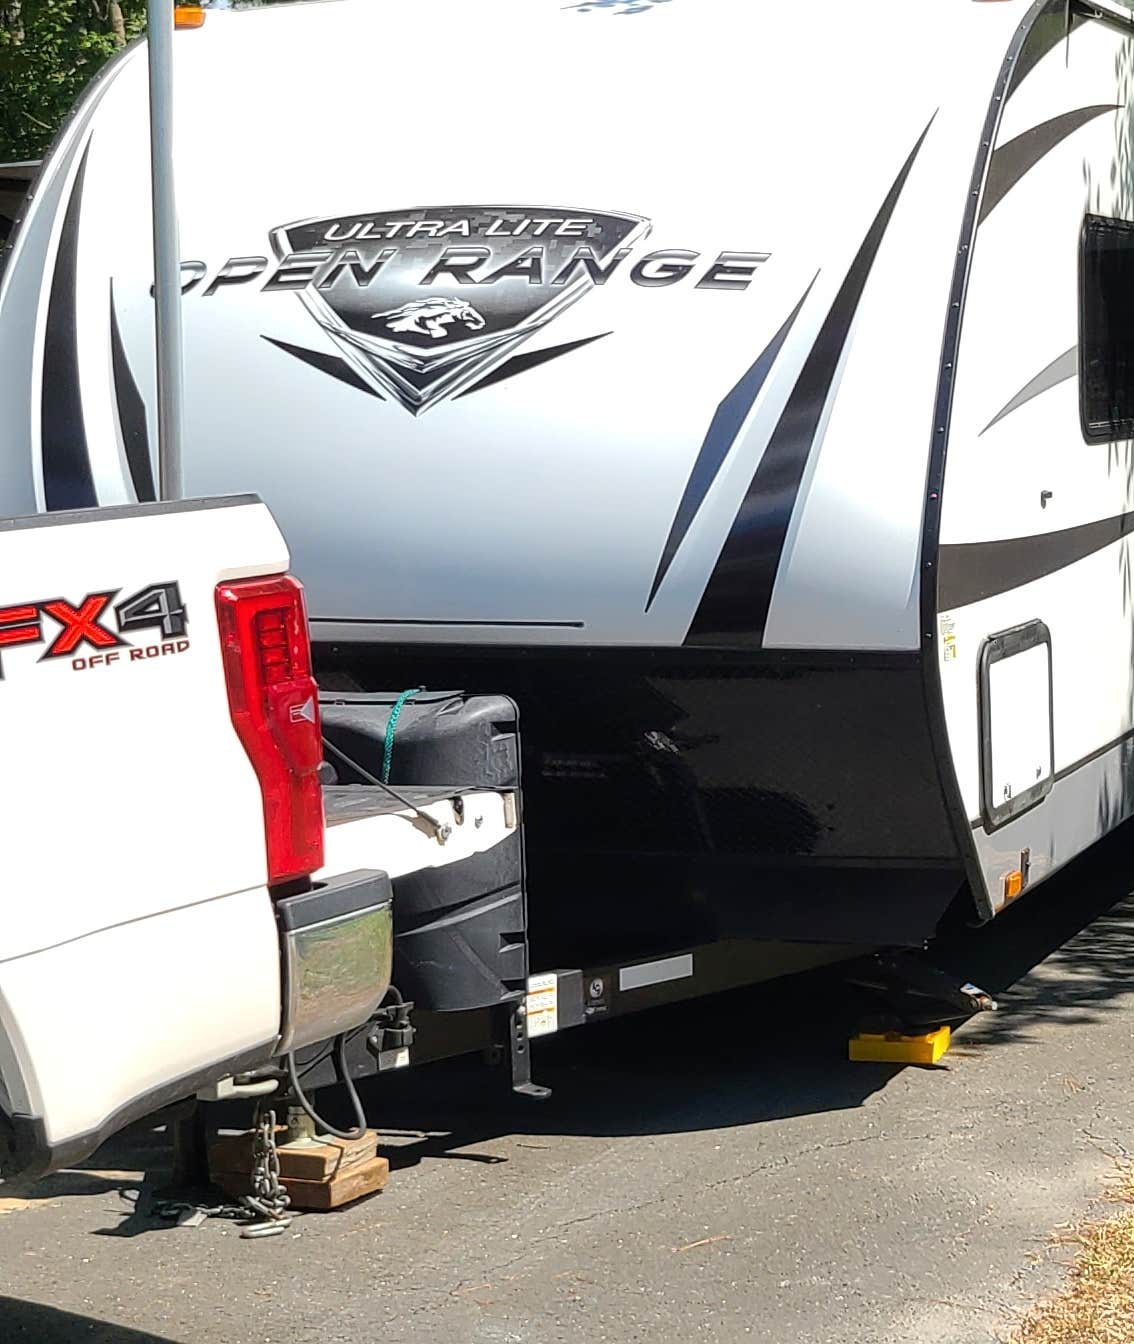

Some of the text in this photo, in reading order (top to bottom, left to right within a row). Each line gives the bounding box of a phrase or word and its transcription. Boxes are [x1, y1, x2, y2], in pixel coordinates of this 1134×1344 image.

[323, 217, 596, 242] ULTRA LITE
[418, 246, 773, 292] RANGE
[0, 579, 190, 680] FX4
[72, 640, 190, 671] OFF ROAD
